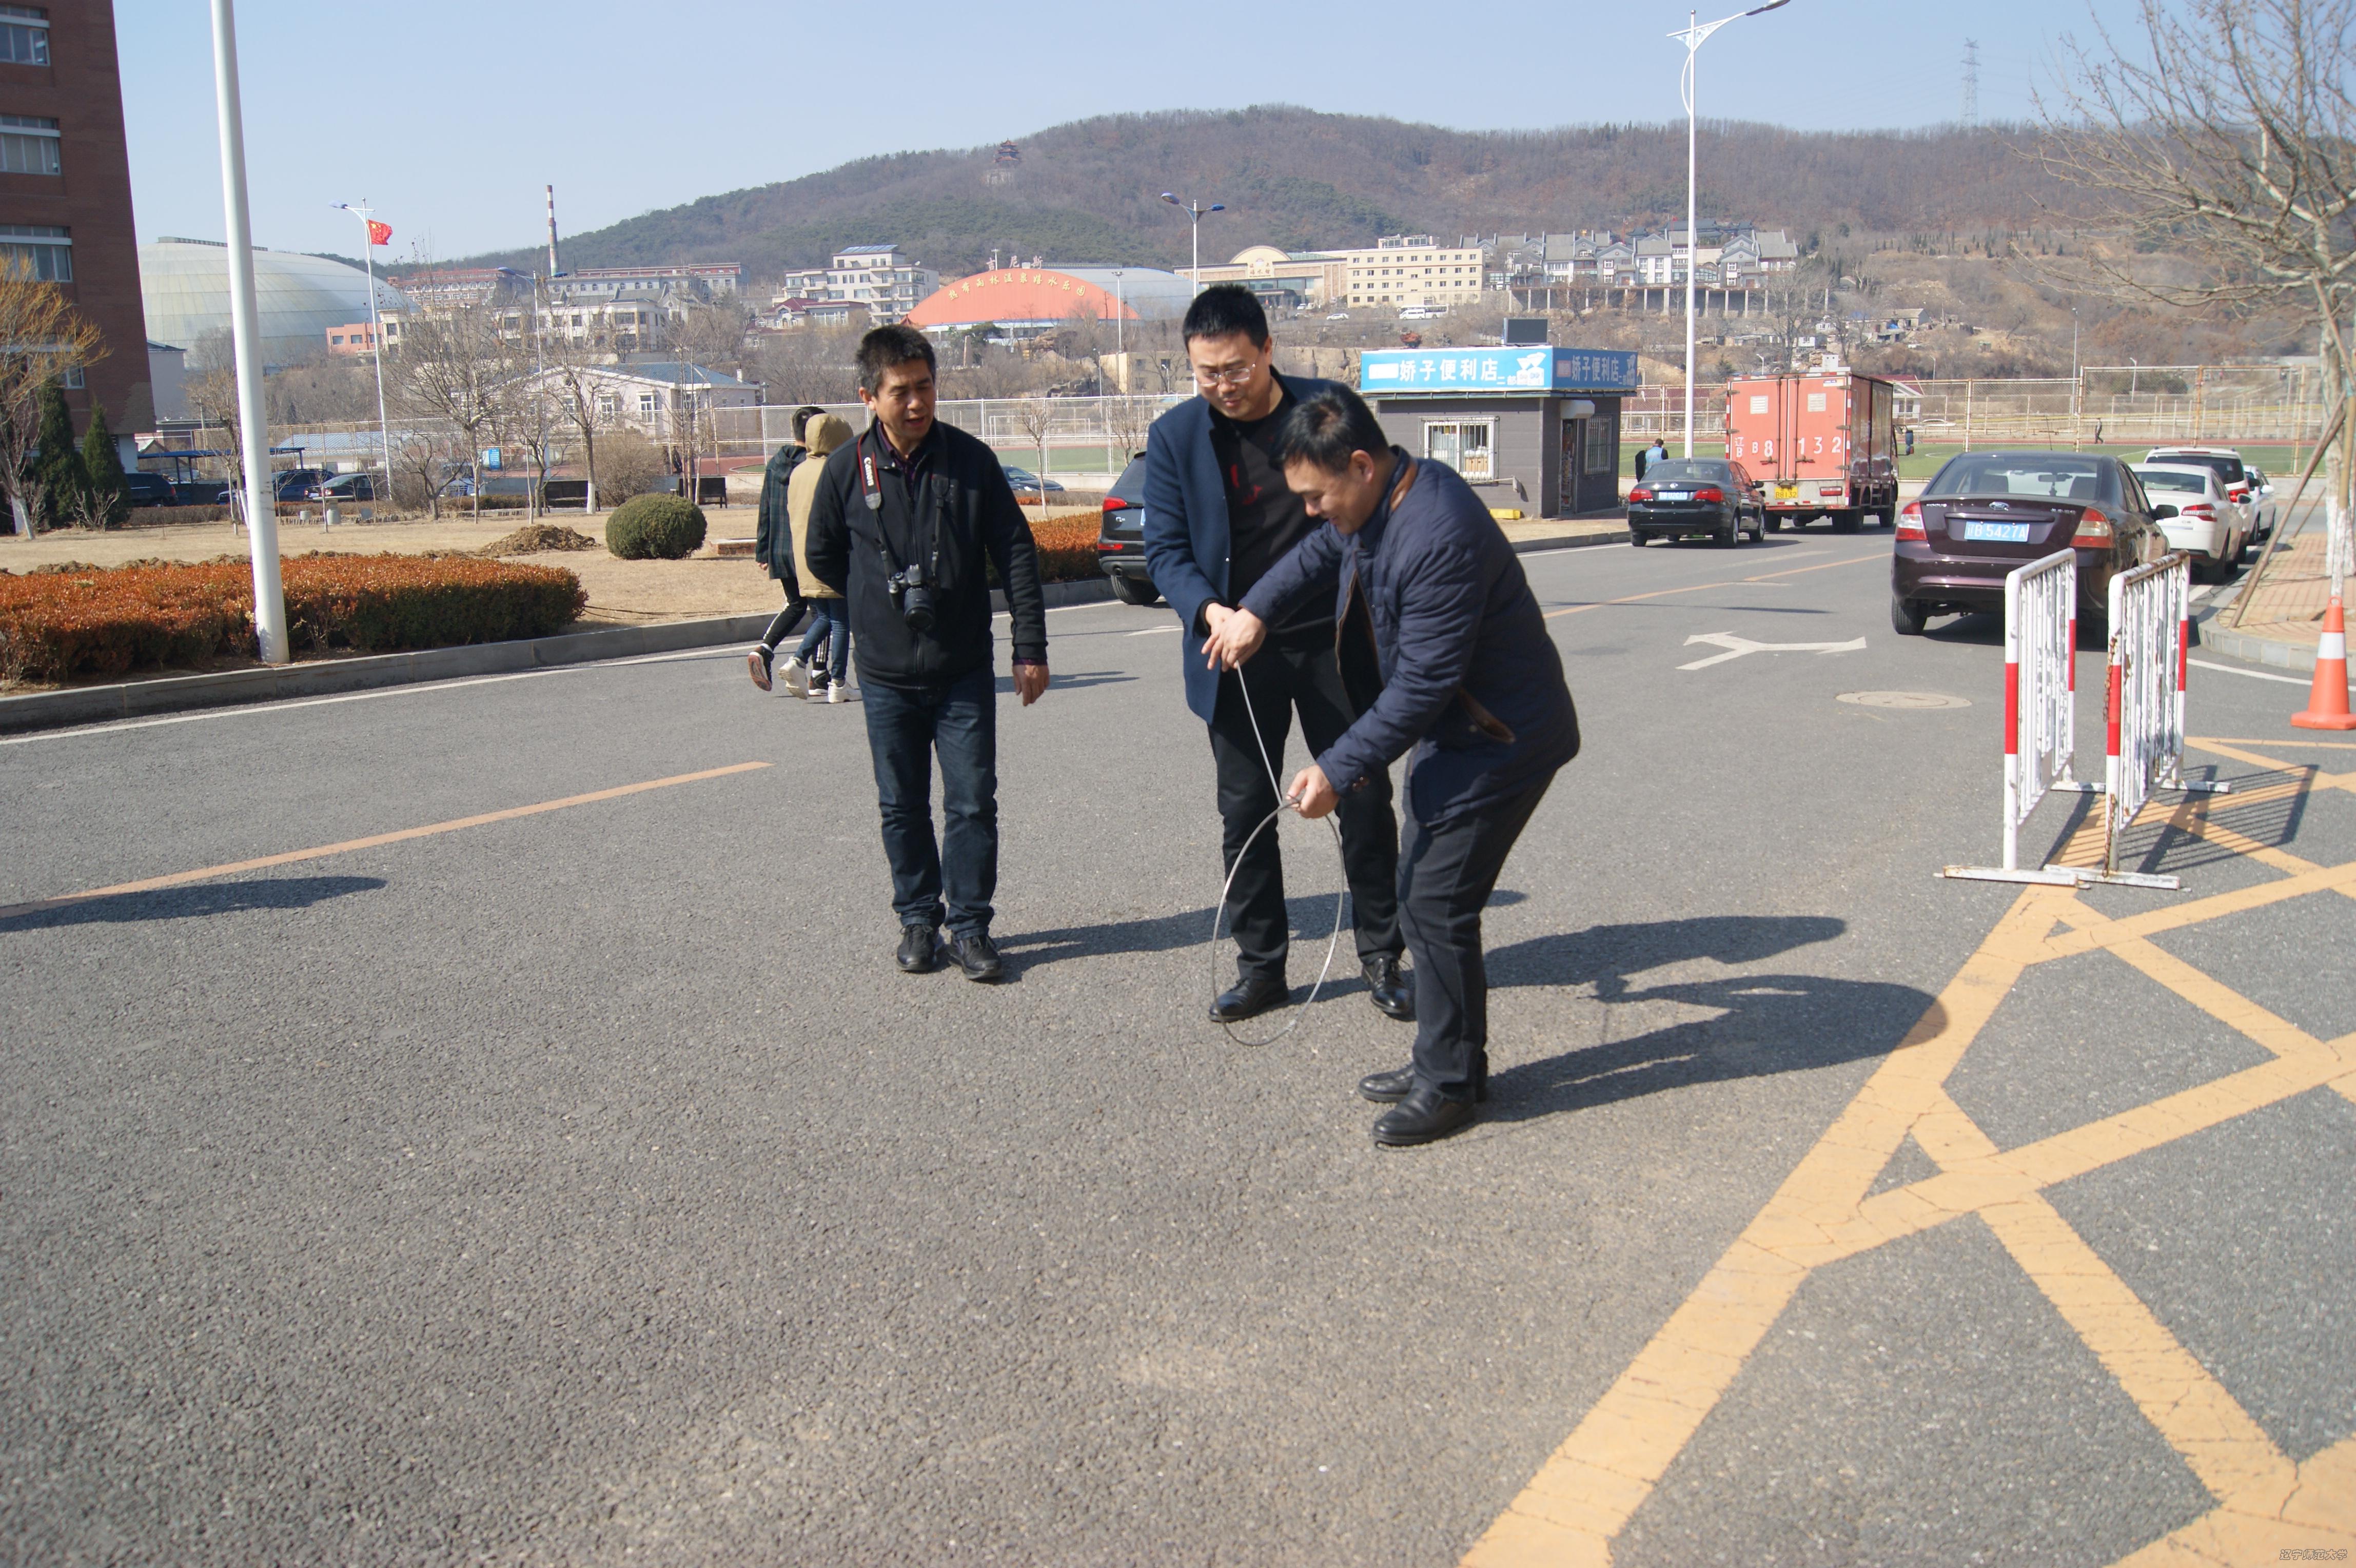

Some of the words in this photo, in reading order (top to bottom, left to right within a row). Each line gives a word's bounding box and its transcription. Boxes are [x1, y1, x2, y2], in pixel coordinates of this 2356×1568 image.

[1399, 358, 1498, 382] 娇子便利店
[1572, 355, 1619, 382] 娇子便利店
[864, 457, 874, 487] Canon
